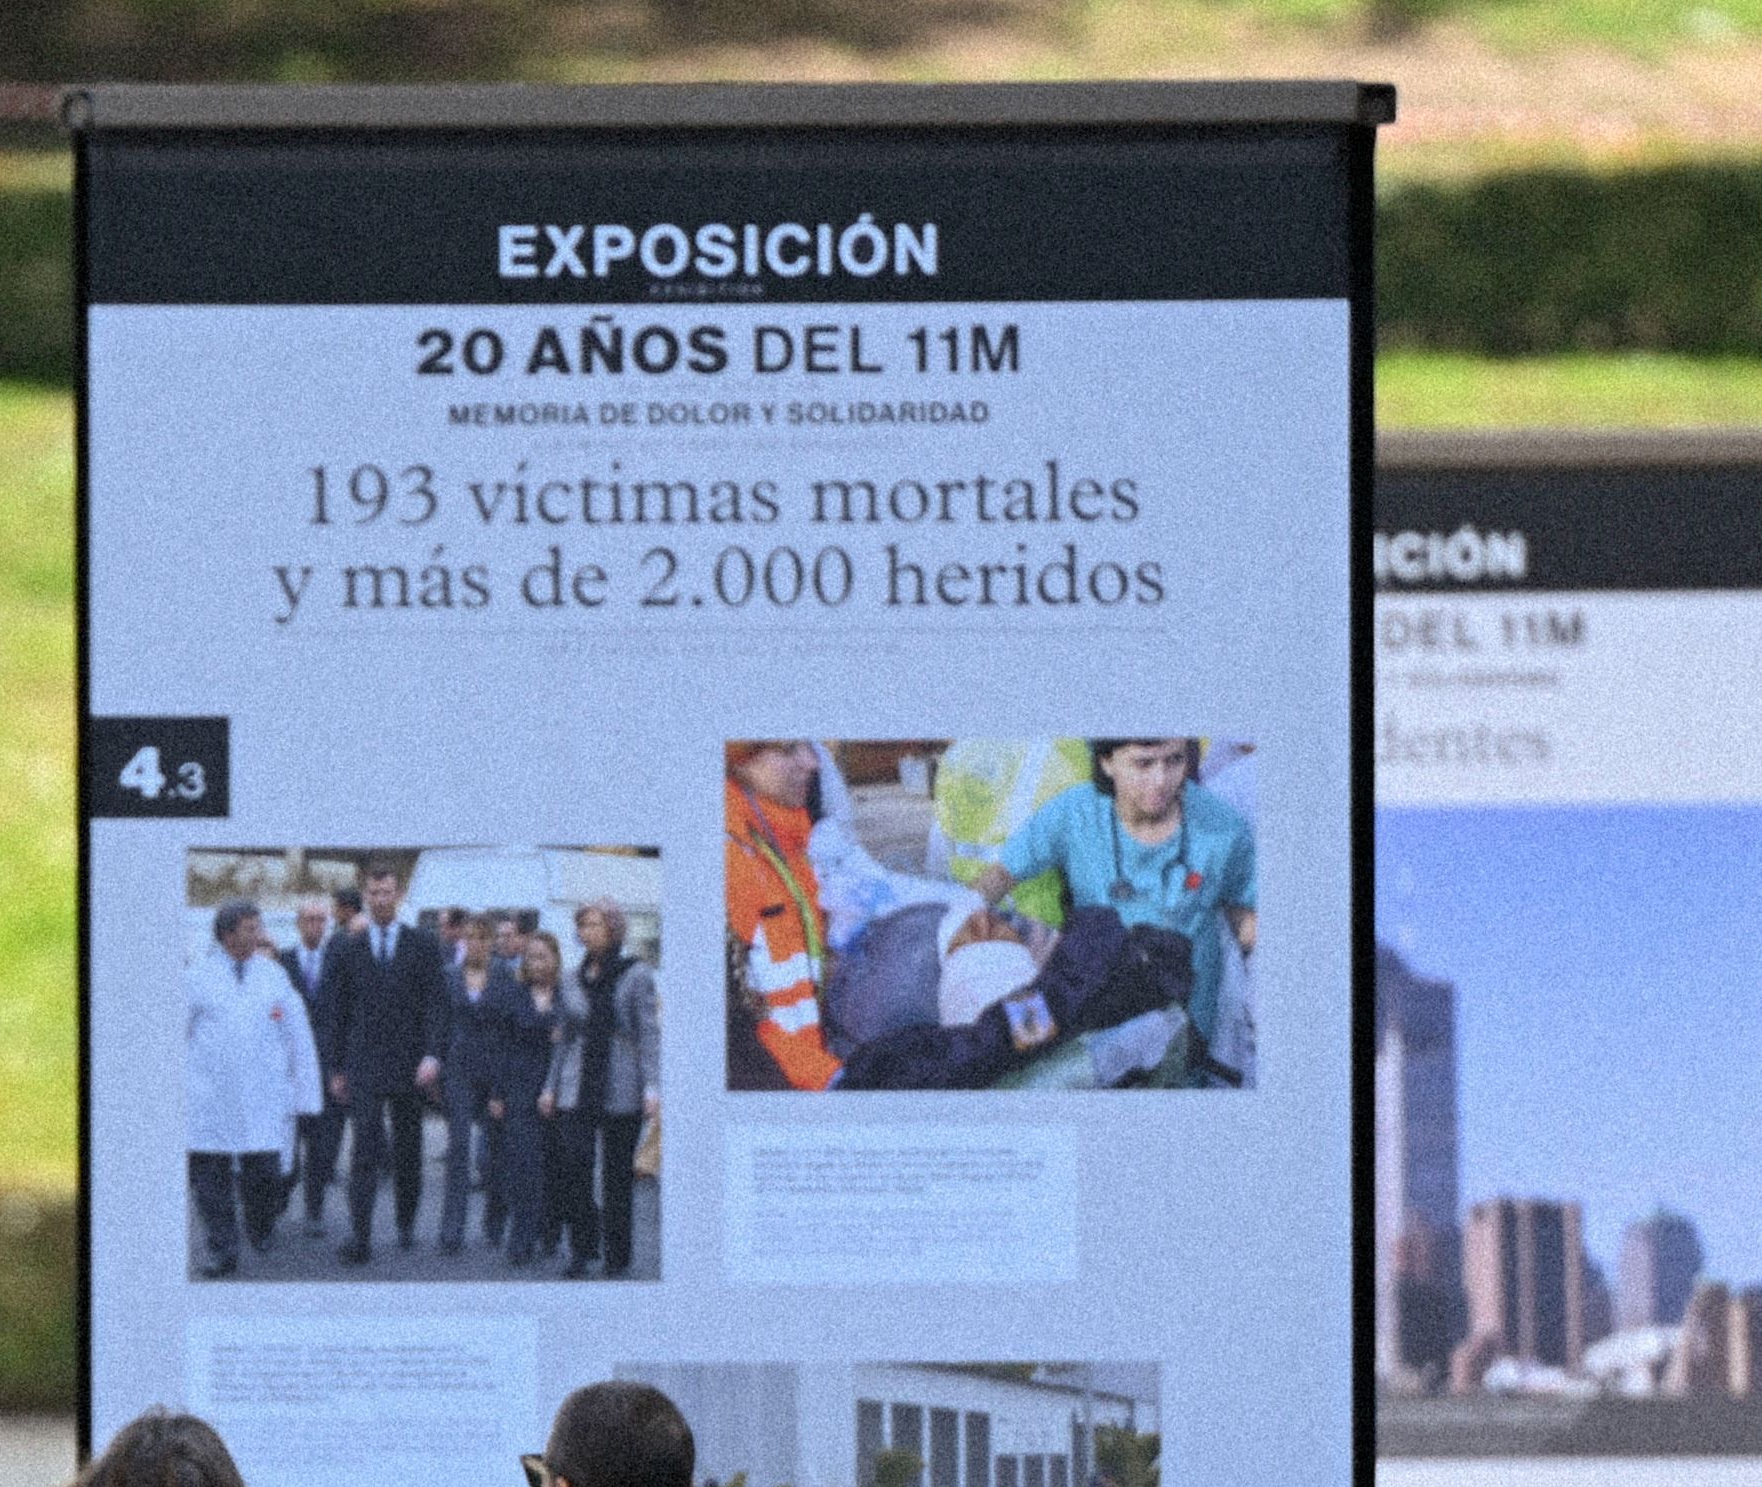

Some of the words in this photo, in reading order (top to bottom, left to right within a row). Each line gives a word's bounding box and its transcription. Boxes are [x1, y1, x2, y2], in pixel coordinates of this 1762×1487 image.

[498, 213, 938, 278] EXPOSICIÓN
[415, 328, 505, 376] 20
[525, 315, 730, 375] AÑOS
[753, 325, 883, 374] DEL
[909, 324, 1021, 373] 11M
[447, 403, 590, 426] MEMORIA
[598, 403, 636, 425] DE
[647, 402, 751, 425] DOLOR
[760, 402, 777, 424] Y
[787, 401, 991, 425] SOLIDARIDAD
[309, 464, 439, 527] 193
[468, 461, 781, 526] víctimas
[810, 459, 1141, 525] mortales
[274, 563, 313, 625] y
[342, 546, 492, 609] más
[520, 545, 610, 609] de
[639, 545, 856, 609] 2.000
[883, 543, 1166, 607] heridos
[119, 745, 206, 799] 4.3
